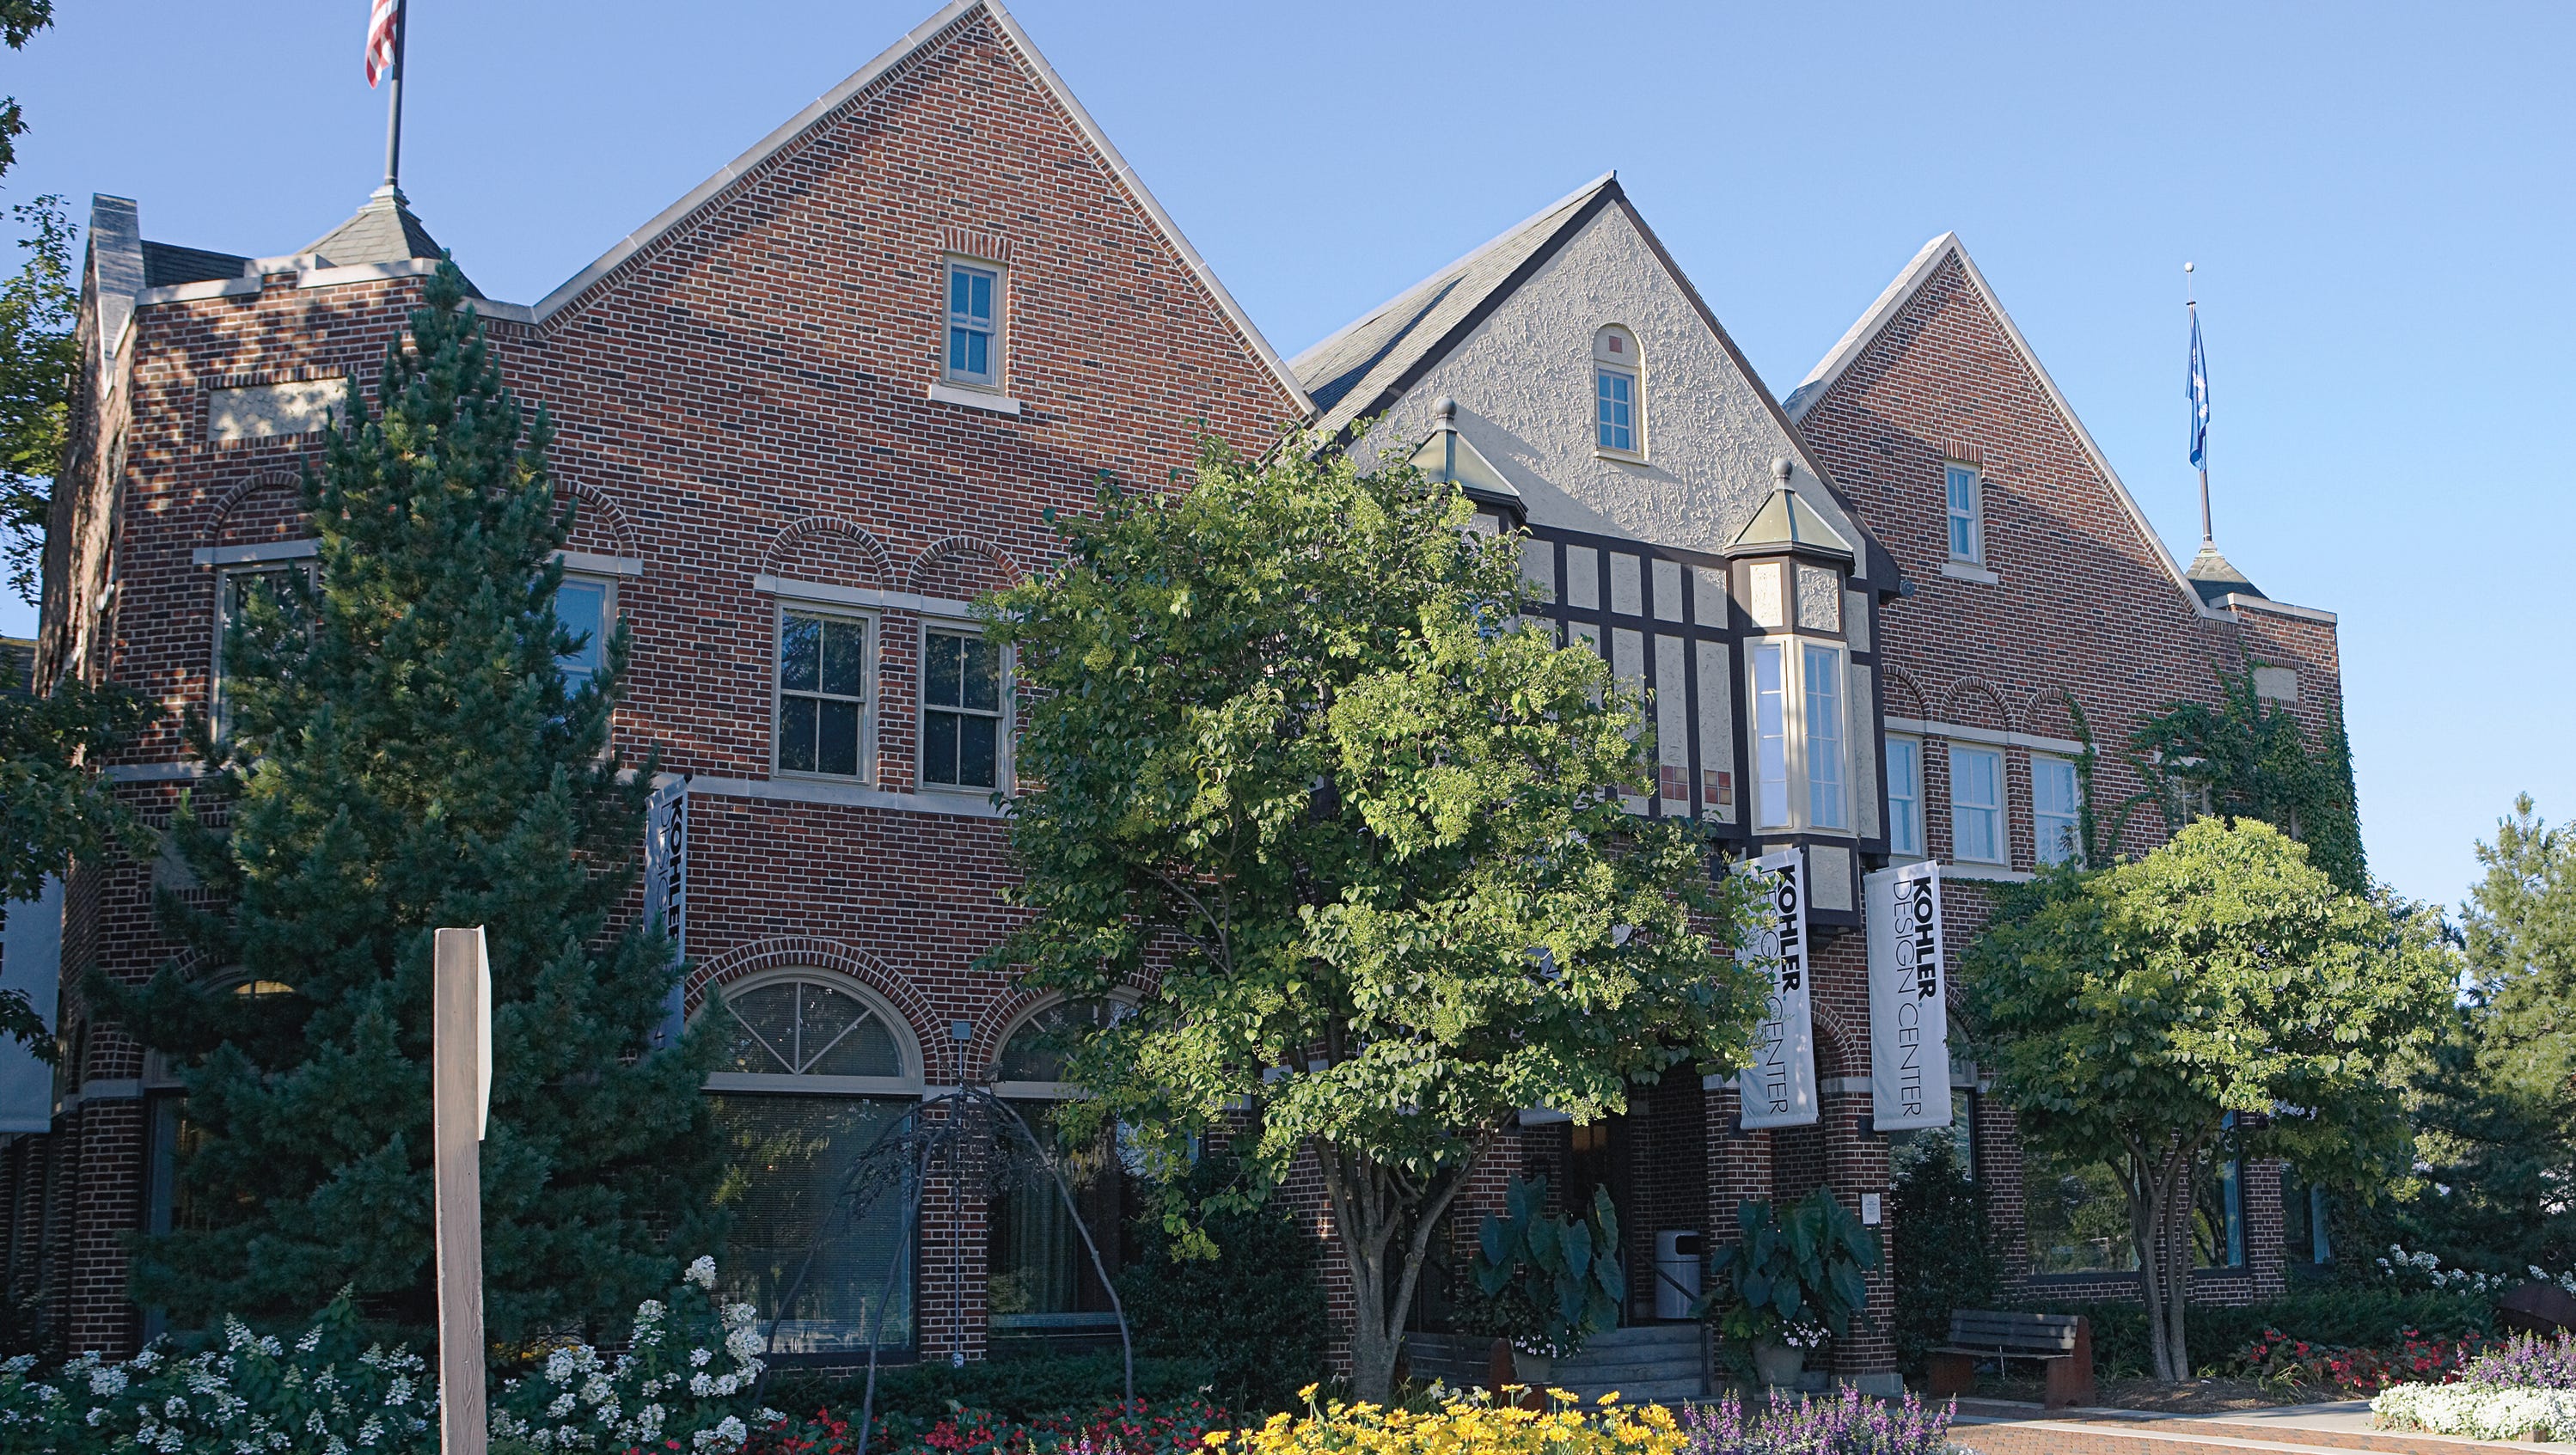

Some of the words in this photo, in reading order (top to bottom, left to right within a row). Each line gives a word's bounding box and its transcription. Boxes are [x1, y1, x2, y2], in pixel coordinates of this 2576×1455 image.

[1777, 864, 1801, 994] KOHLER
[1894, 880, 1916, 993] DESIGN
[1913, 876, 1937, 1002] KOHLER
[1898, 1003, 1922, 1117] CENTER
